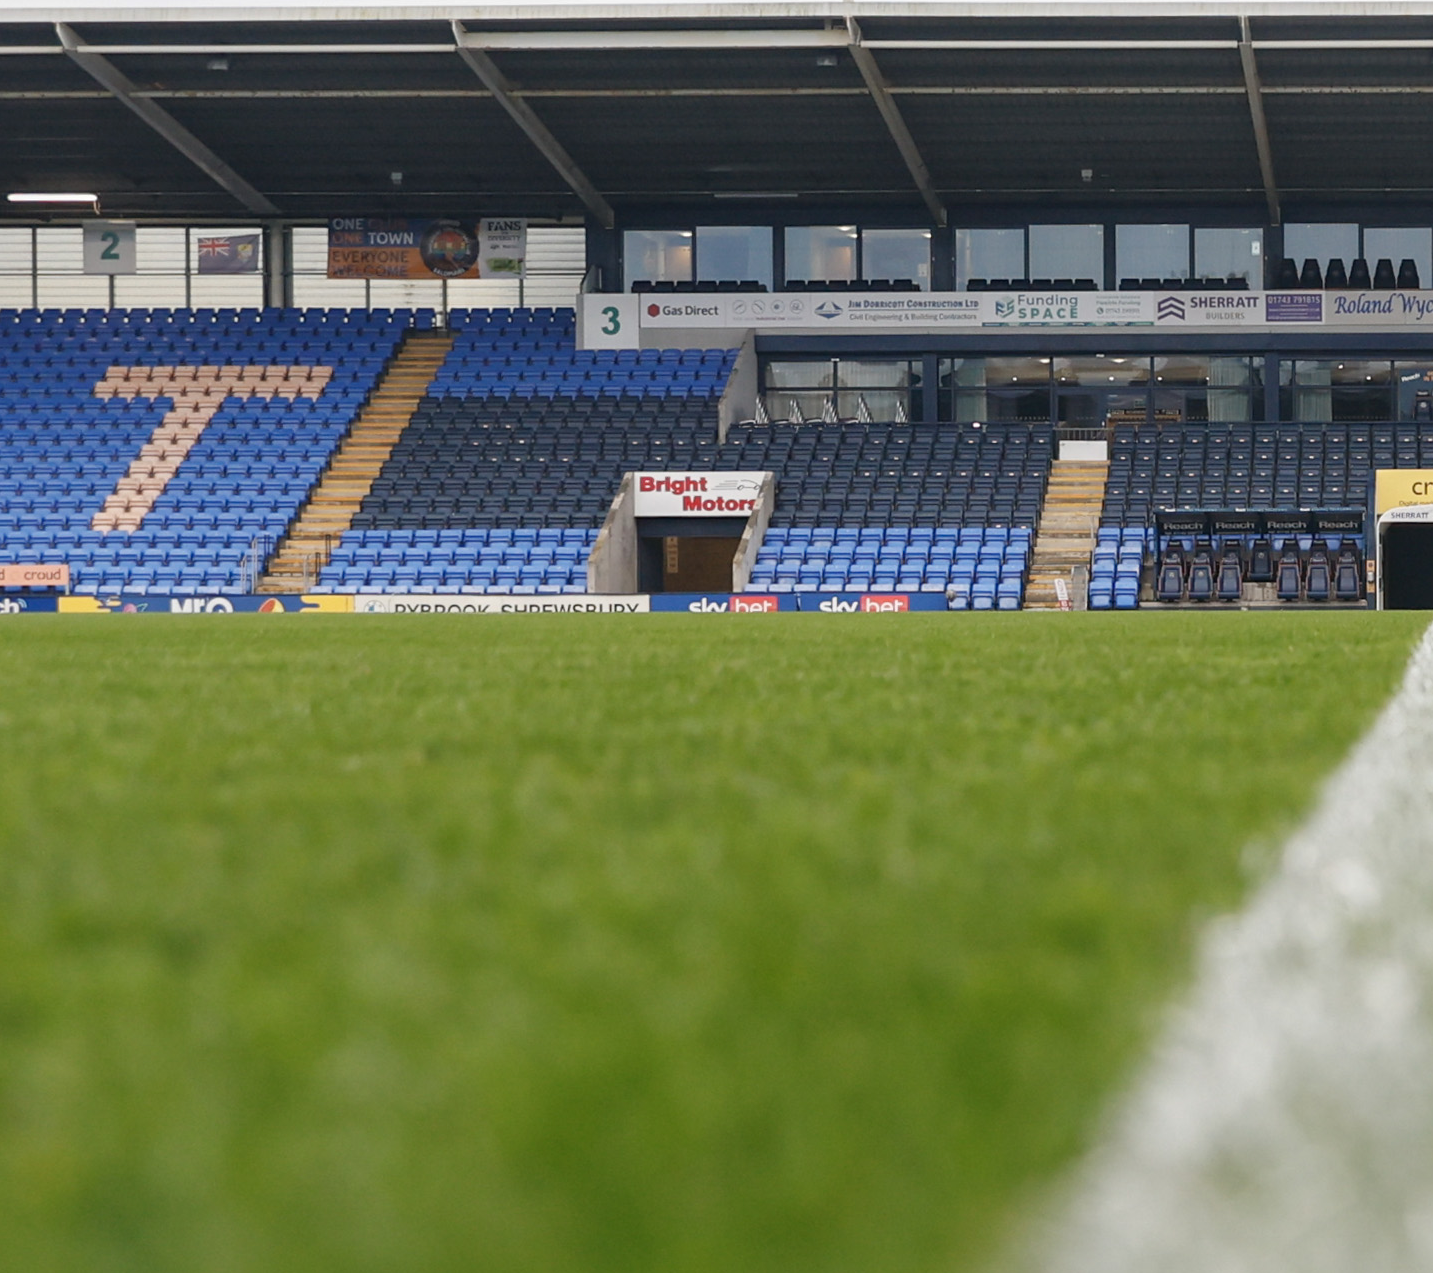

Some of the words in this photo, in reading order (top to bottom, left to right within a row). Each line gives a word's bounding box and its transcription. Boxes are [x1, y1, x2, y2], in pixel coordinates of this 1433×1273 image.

[332, 218, 364, 230] ONE
[487, 221, 521, 231] FANS
[368, 232, 414, 245] TOWN
[101, 231, 120, 260] 2
[332, 251, 409, 263] EVERYONE
[333, 264, 408, 276] WELCOME
[1018, 294, 1078, 307] Funding
[1190, 297, 1259, 308] SHERRATT
[1267, 296, 1290, 304] 01743
[1334, 293, 1396, 314] Roland
[662, 306, 683, 316] Gas
[685, 305, 719, 316] Direct
[1018, 308, 1078, 319] SPACE
[1206, 312, 1245, 320] BUILDERS
[601, 306, 621, 335] 3
[639, 476, 707, 495] Bright
[1164, 522, 1203, 530] Reach
[1216, 521, 1255, 529] Reach
[1267, 521, 1307, 529] Reach
[1319, 521, 1358, 529] Reach
[24, 569, 61, 581] croud
[689, 597, 727, 612] sky
[736, 598, 772, 612] bet
[819, 597, 858, 612] sky
[866, 598, 904, 612] bet
